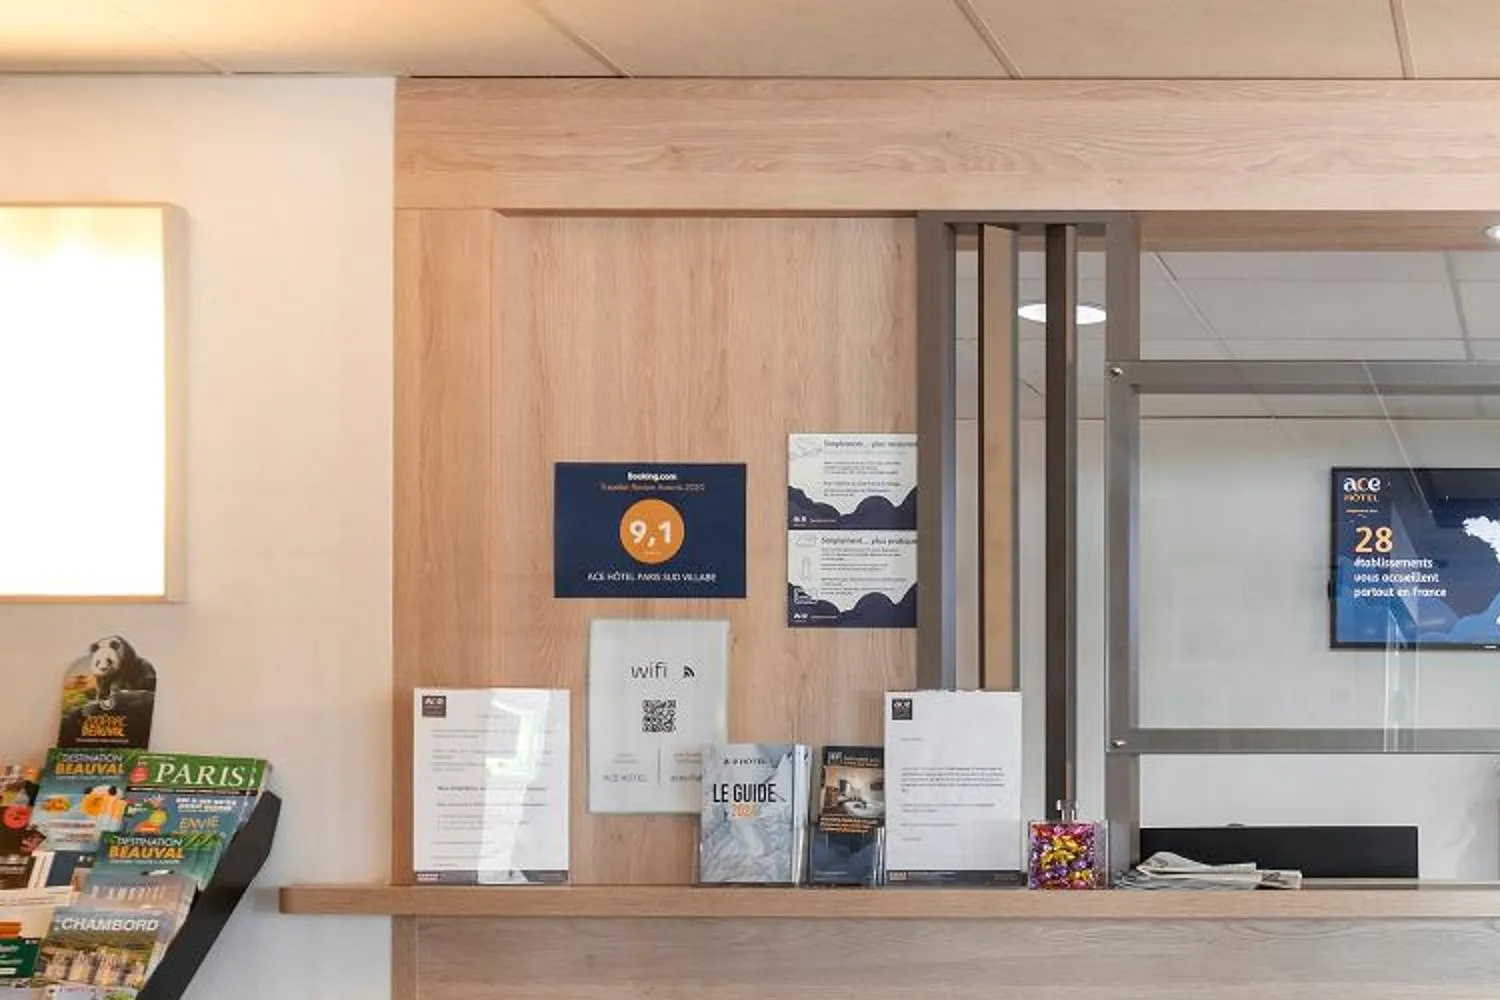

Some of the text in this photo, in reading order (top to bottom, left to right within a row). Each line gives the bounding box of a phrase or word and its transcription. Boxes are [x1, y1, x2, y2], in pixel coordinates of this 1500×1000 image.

[627, 472, 677, 481] Booking.com
[1343, 477, 1381, 492] ace
[629, 520, 672, 548] 9,1
[1355, 527, 1393, 552] 28
[1354, 557, 1433, 568] établissements
[1354, 573, 1379, 582] vous
[1354, 588, 1393, 598] partout
[631, 662, 668, 679] wifi
[55, 762, 125, 776] BEAUVAL
[155, 763, 245, 786] PARIS
[713, 783, 777, 803] LE GUIDE
[117, 836, 184, 847] DESTINATION
[108, 846, 185, 860] BEAUVAL
[61, 918, 159, 931] CHAMBORD
